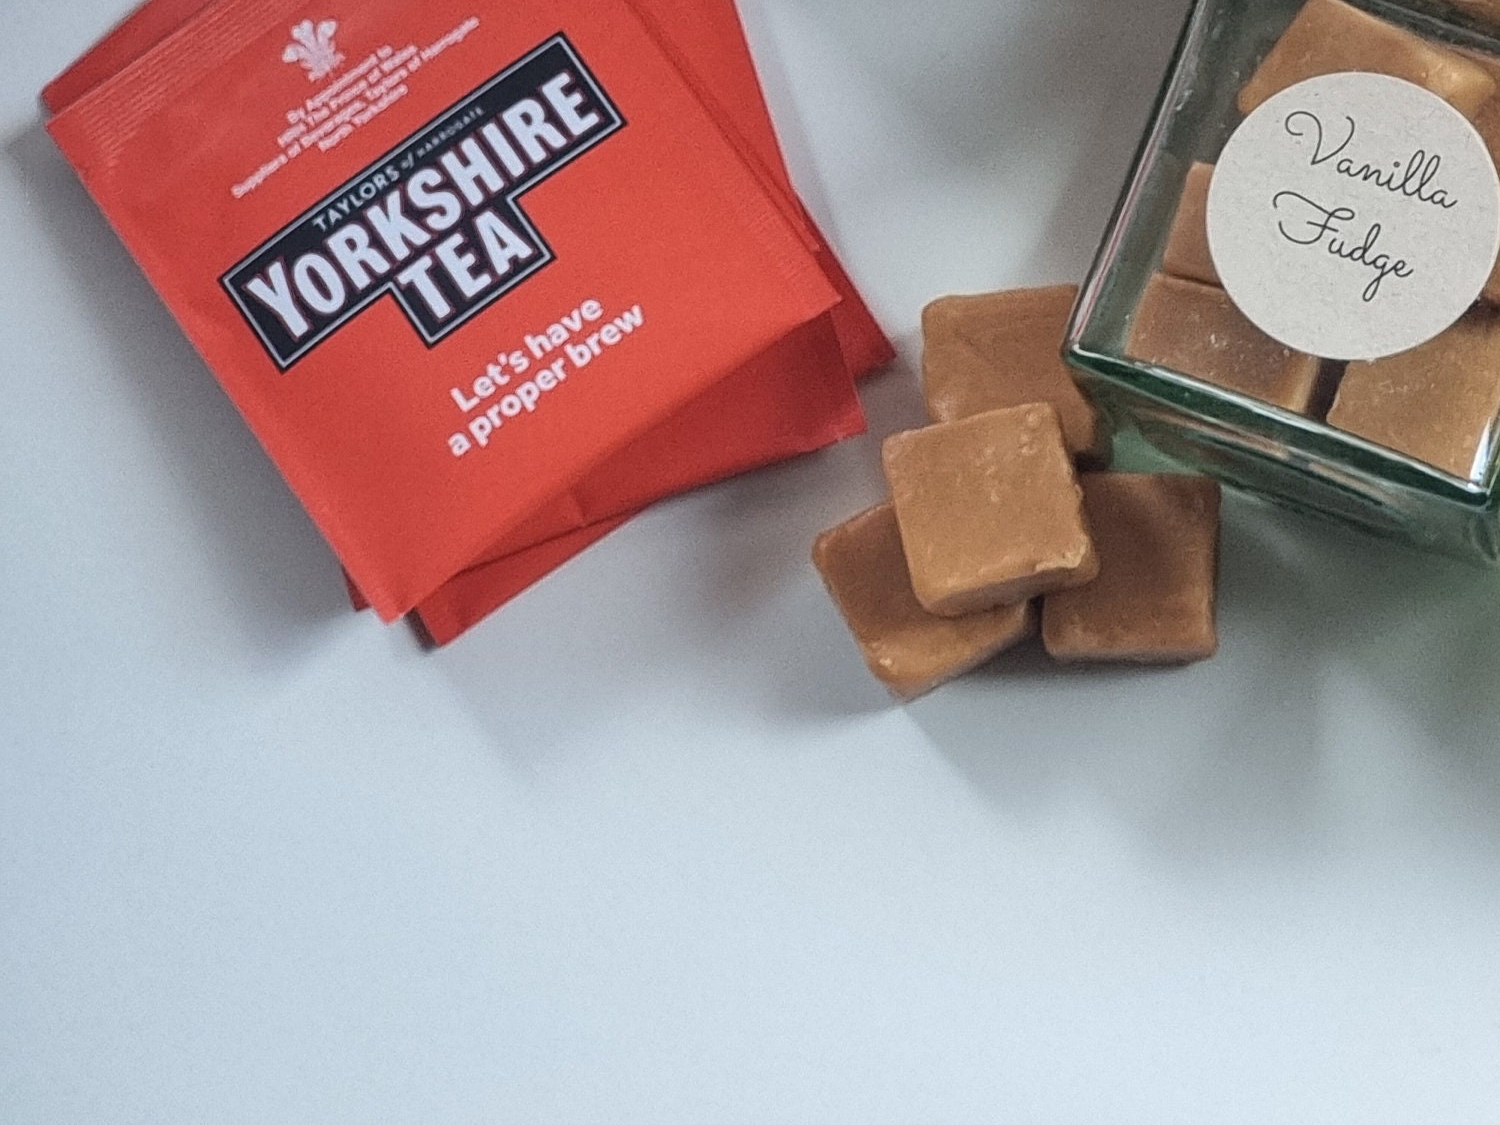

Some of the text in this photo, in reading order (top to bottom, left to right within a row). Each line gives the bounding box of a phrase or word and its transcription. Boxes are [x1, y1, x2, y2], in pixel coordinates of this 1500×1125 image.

[247, 72, 600, 337] YORKSHIRE
[312, 164, 400, 233] TAYLORS
[401, 152, 414, 170] of
[1285, 111, 1458, 209] Vanilla
[399, 211, 534, 320] TEA
[1273, 191, 1414, 302] Fudge
[448, 304, 645, 457] a proper brew
[524, 297, 604, 361] have
